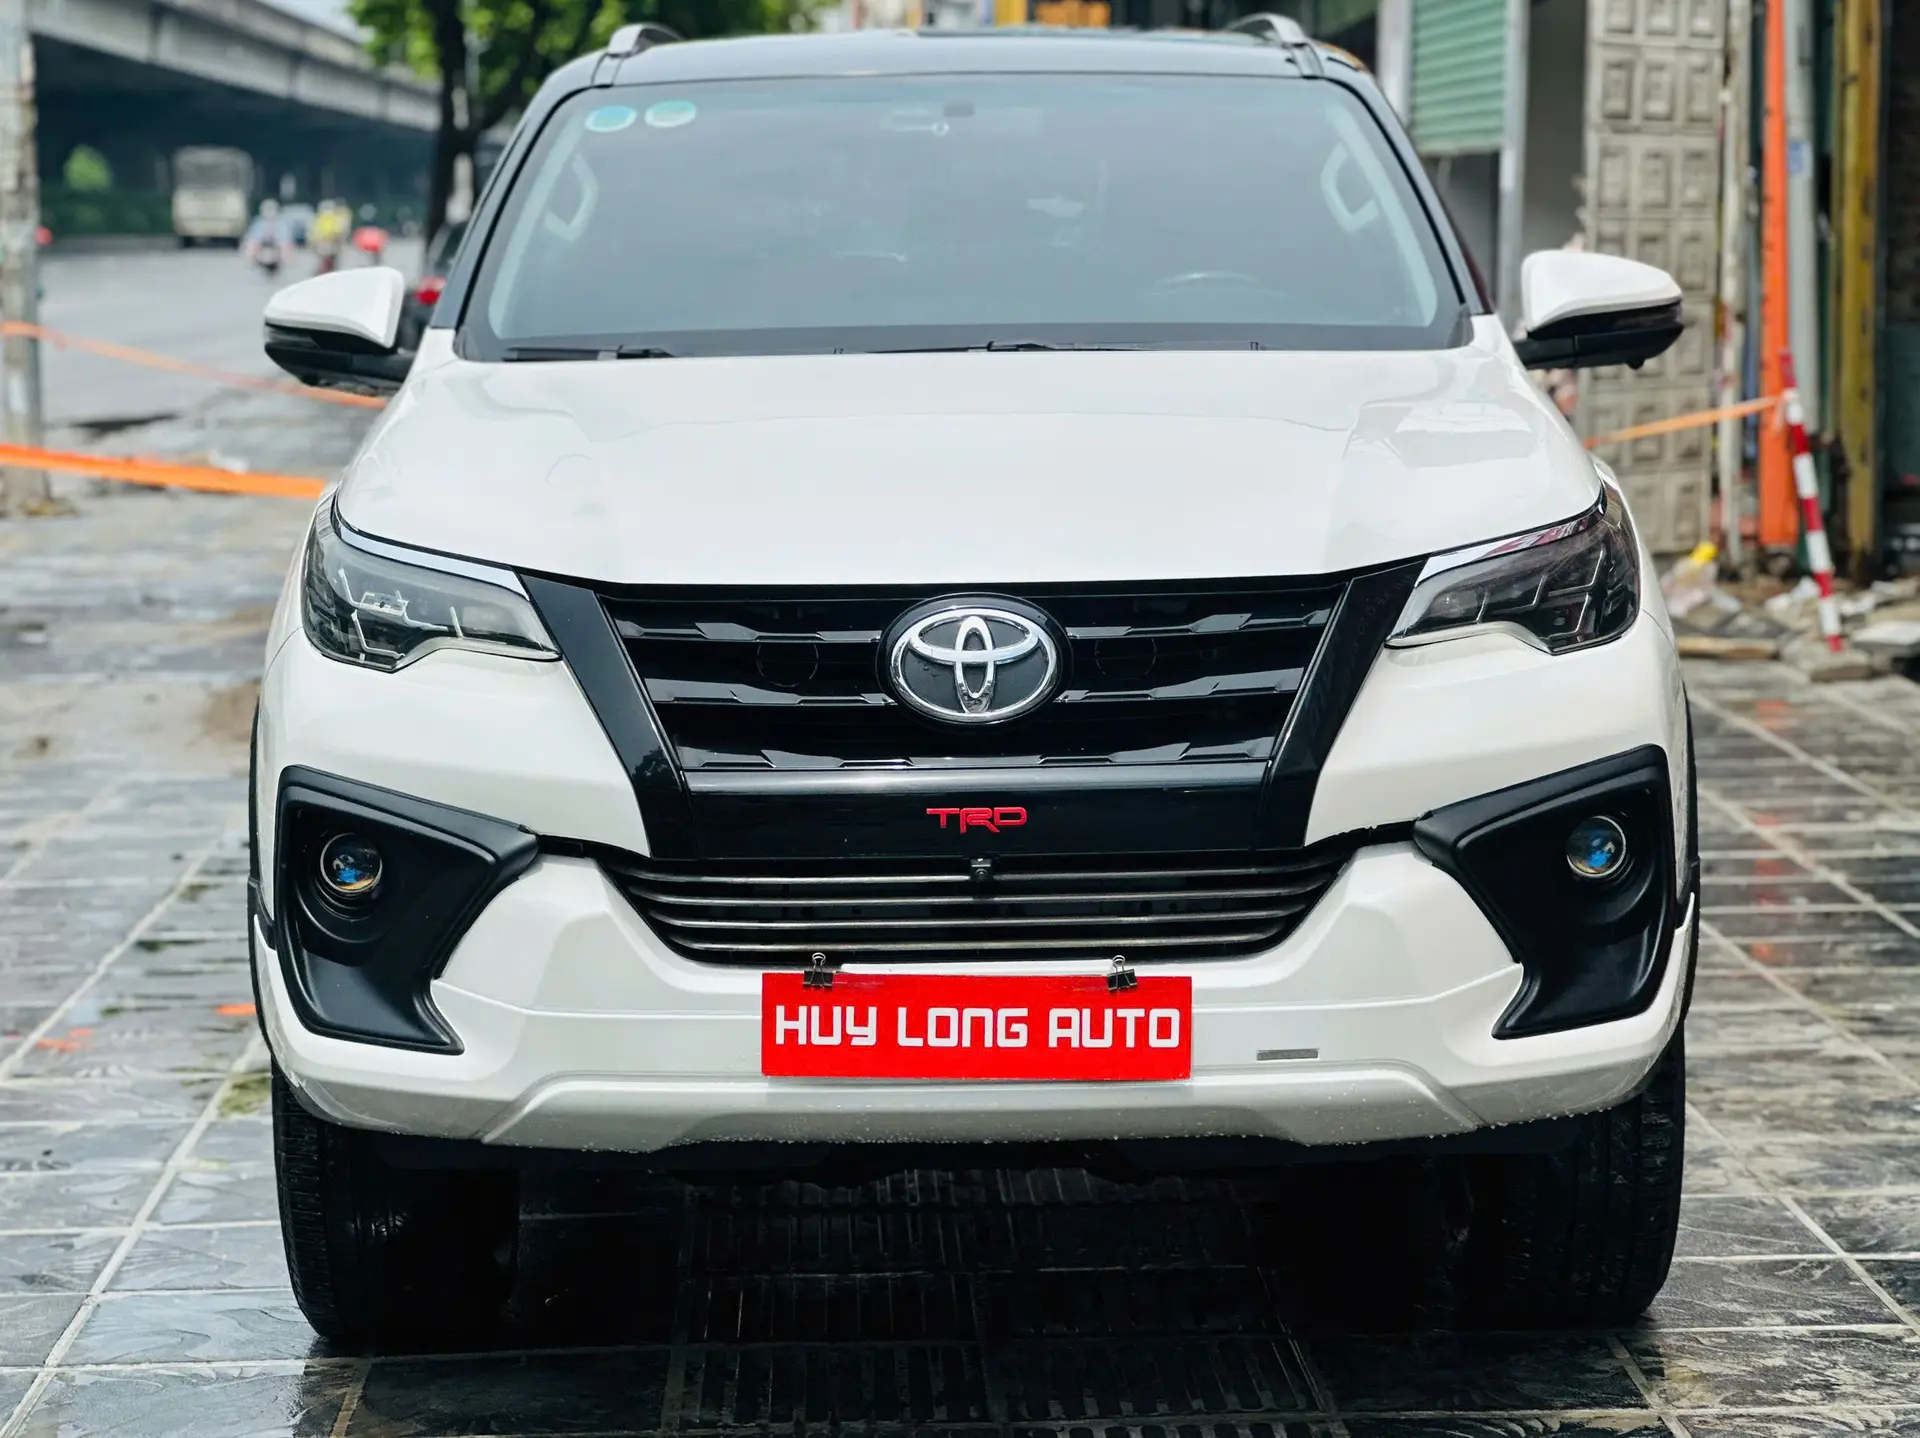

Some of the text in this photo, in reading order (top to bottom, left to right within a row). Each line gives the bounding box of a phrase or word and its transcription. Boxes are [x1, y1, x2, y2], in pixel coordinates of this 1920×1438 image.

[926, 806, 1028, 833] TRD
[775, 1005, 1181, 1048] HUY LONG AUTO
